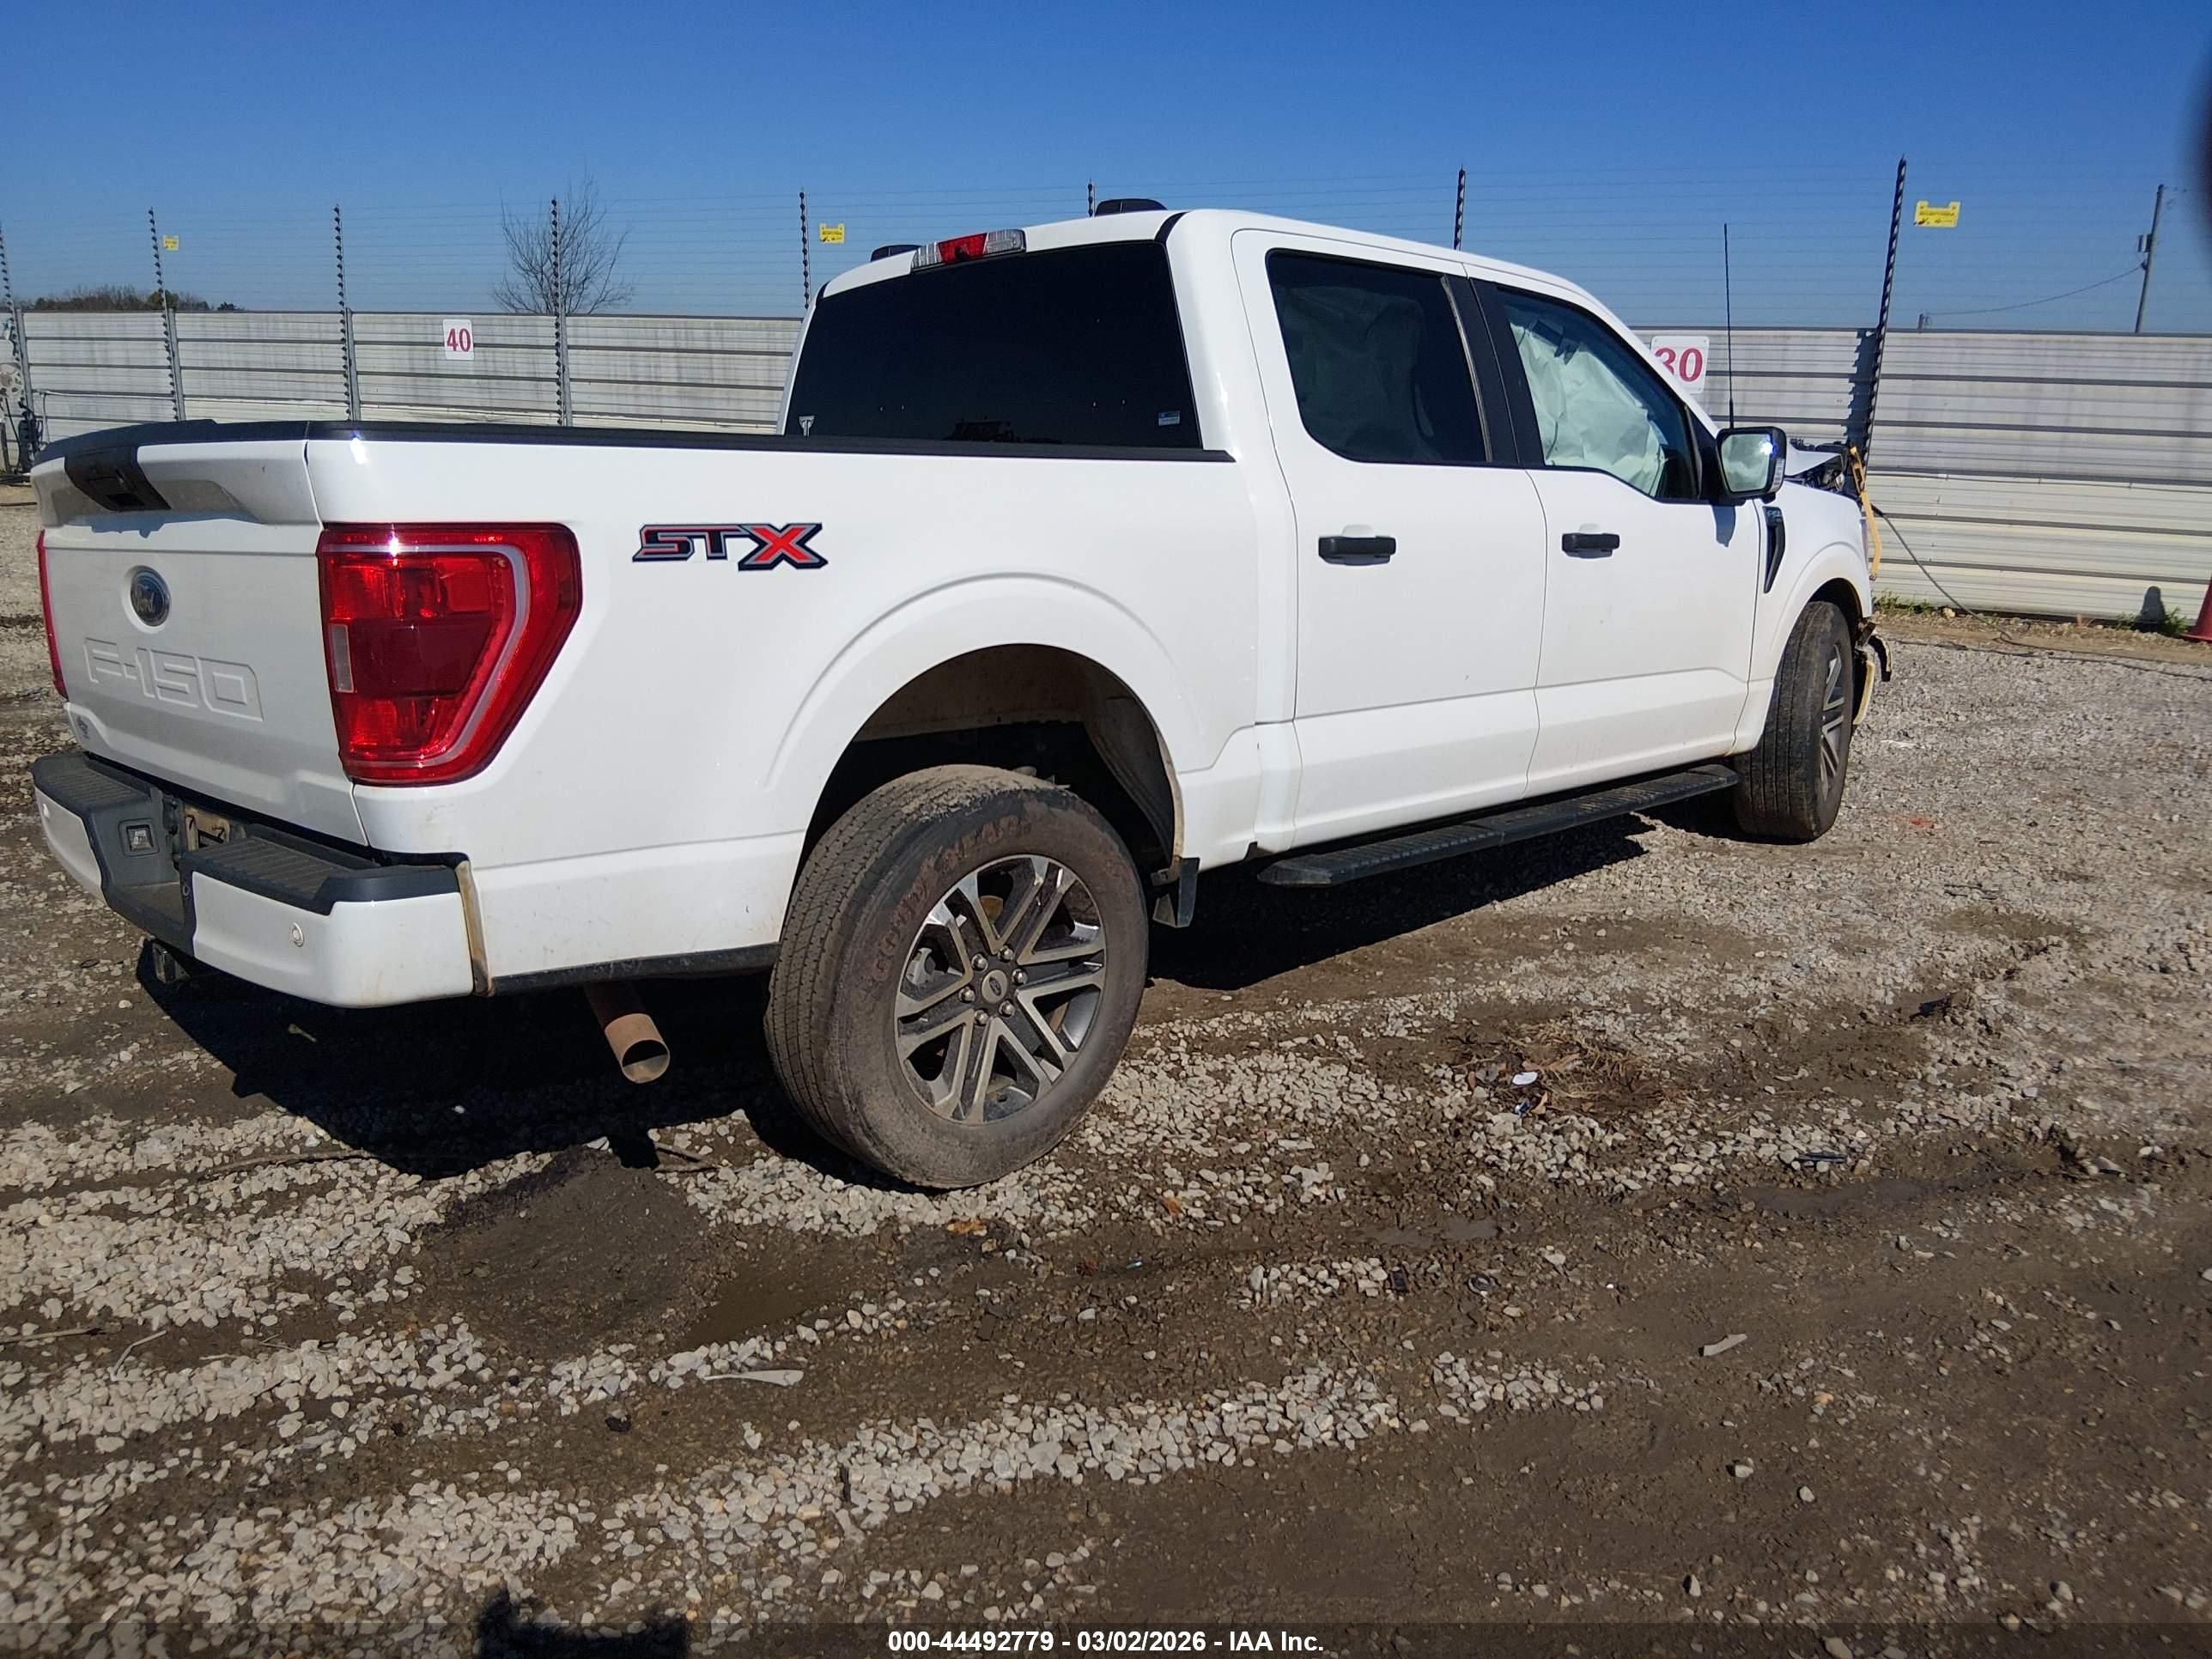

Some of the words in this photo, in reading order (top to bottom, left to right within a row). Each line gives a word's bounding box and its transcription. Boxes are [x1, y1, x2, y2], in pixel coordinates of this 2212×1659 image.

[447, 328, 471, 352] 40
[1654, 347, 1704, 382] 30
[632, 522, 829, 572] STX
[84, 636, 264, 722] F-150
